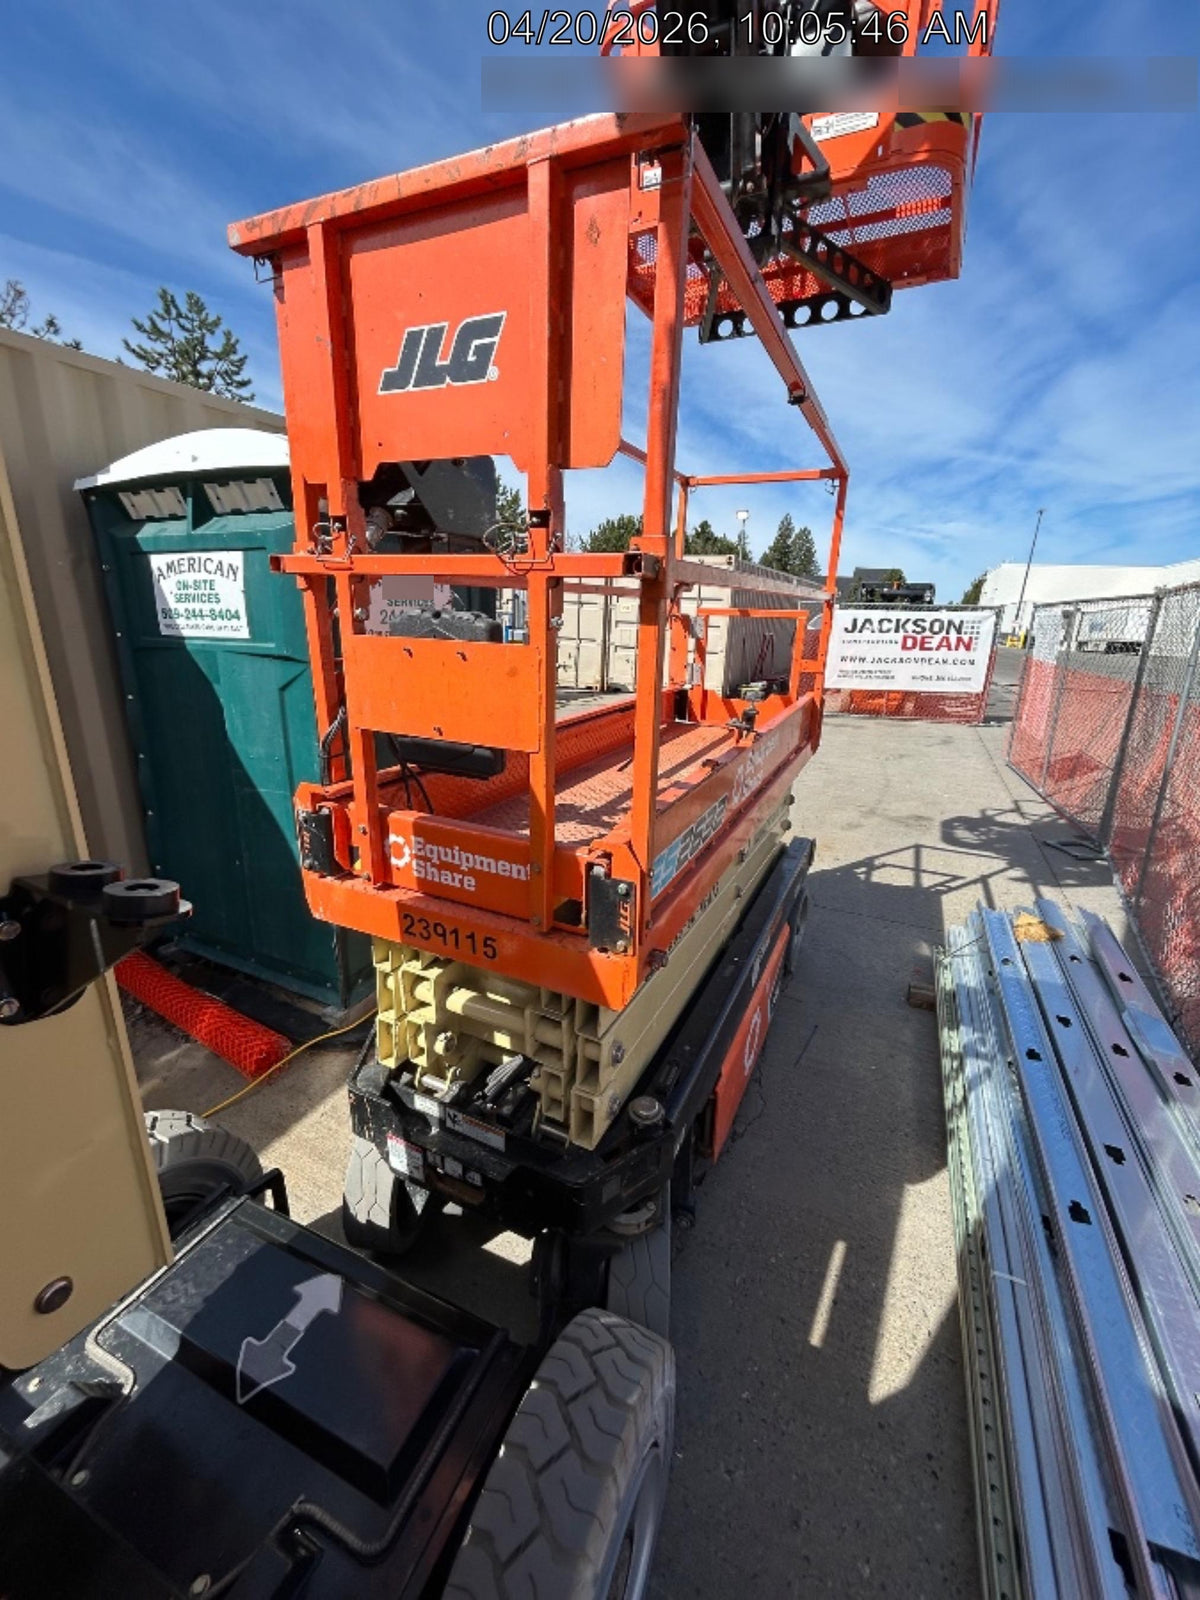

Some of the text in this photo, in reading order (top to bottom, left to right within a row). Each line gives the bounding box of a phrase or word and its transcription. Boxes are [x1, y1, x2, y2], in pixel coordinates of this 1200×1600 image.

[377, 310, 507, 395] JLG
[156, 556, 239, 584] AMERICAN
[175, 579, 216, 591] ON-SITE
[173, 593, 221, 604] SERVICES
[843, 618, 964, 636] JACKSON
[901, 635, 974, 652] DEAN
[840, 655, 976, 667] WWW.JACKSONDEAN.COM
[412, 859, 476, 892] Share
[402, 912, 498, 960] 239115
